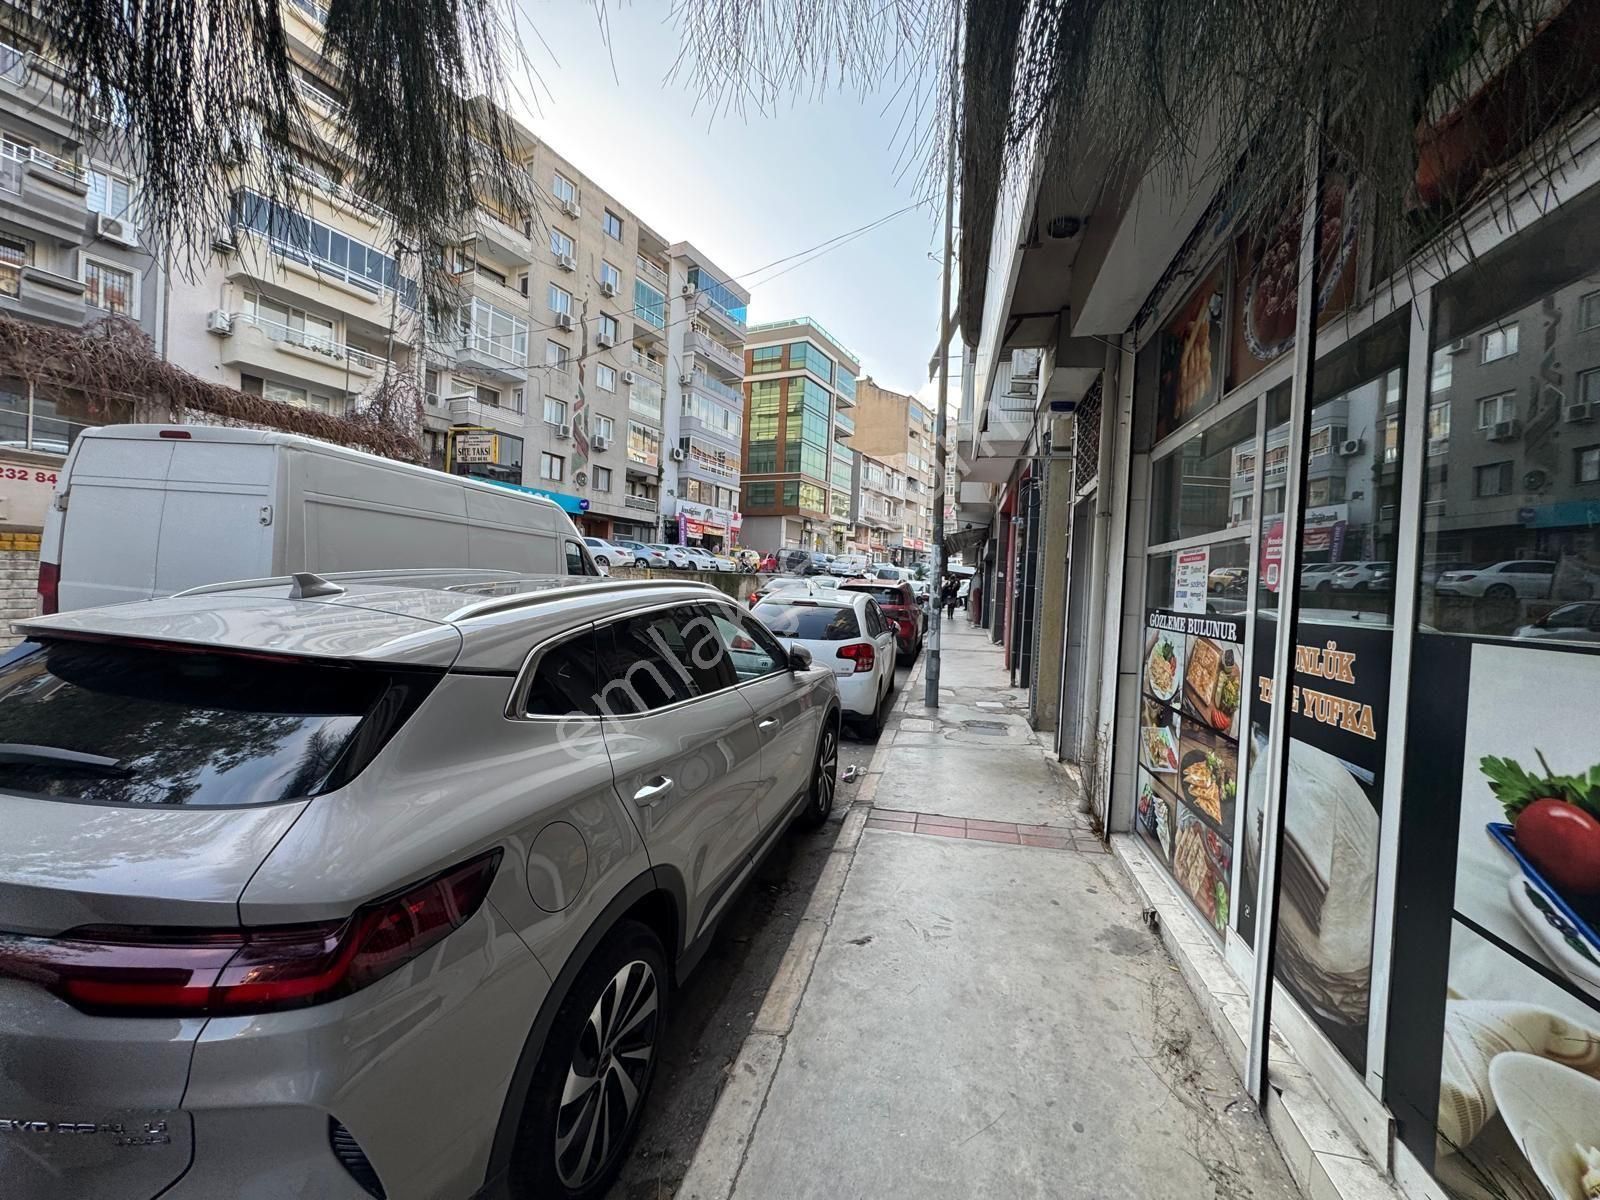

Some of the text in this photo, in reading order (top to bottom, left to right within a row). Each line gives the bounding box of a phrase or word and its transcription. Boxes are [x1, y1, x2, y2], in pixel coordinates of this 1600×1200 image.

[1149, 610, 1237, 641] GÖZLEME BULUNUR
[1302, 687, 1377, 740] YUFKA
